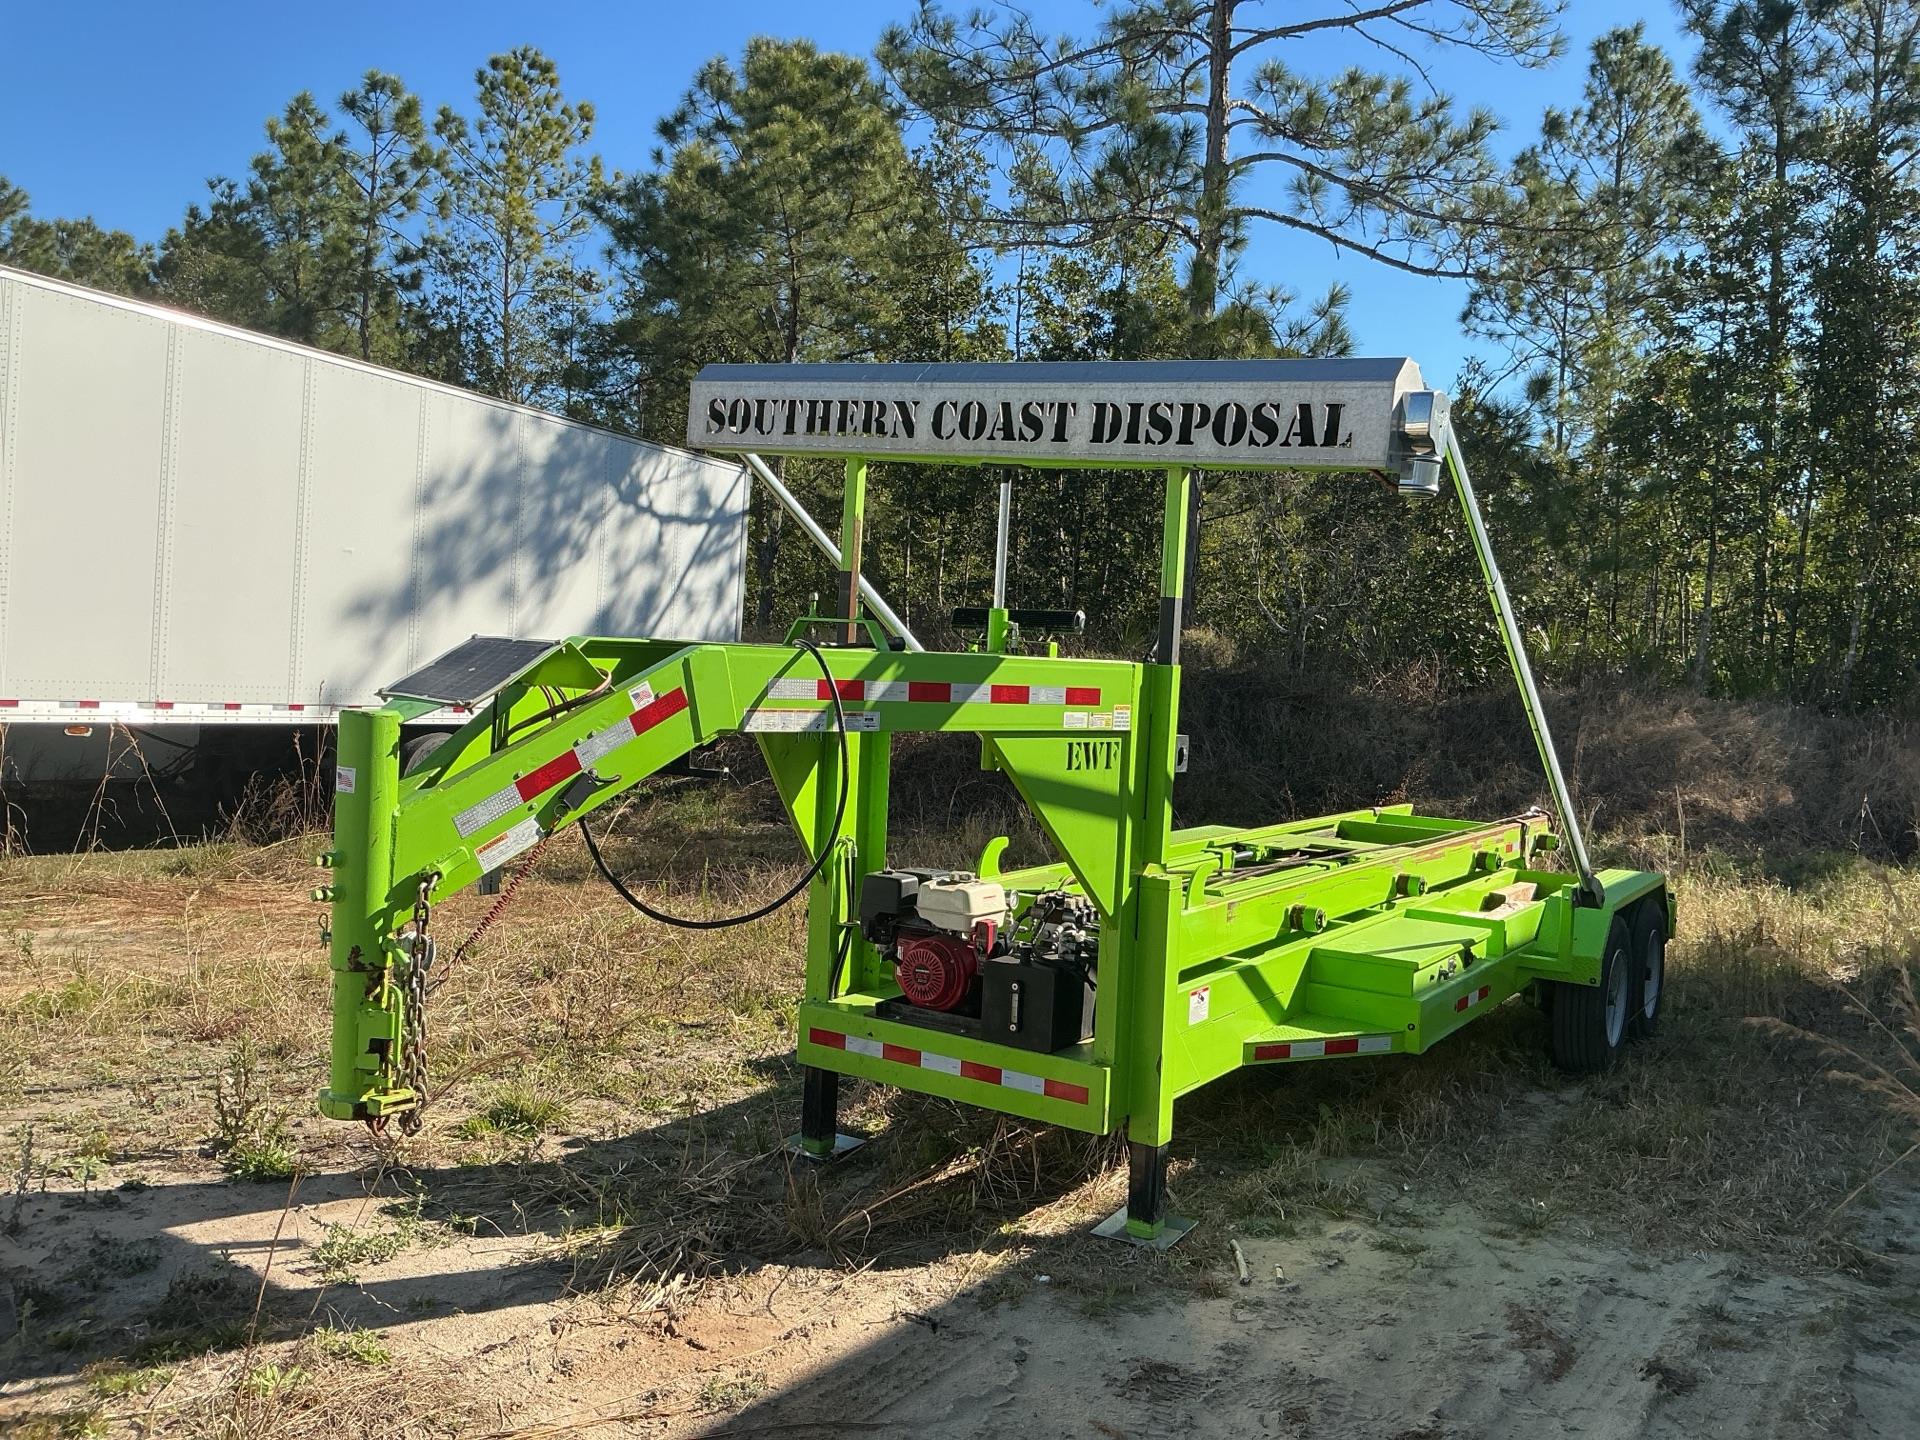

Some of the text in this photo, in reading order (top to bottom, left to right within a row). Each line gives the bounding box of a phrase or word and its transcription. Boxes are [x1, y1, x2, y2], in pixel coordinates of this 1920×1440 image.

[706, 398, 1353, 449] SOUTHERN COAST DISPOSAL
[1066, 741, 1120, 771] EWF
